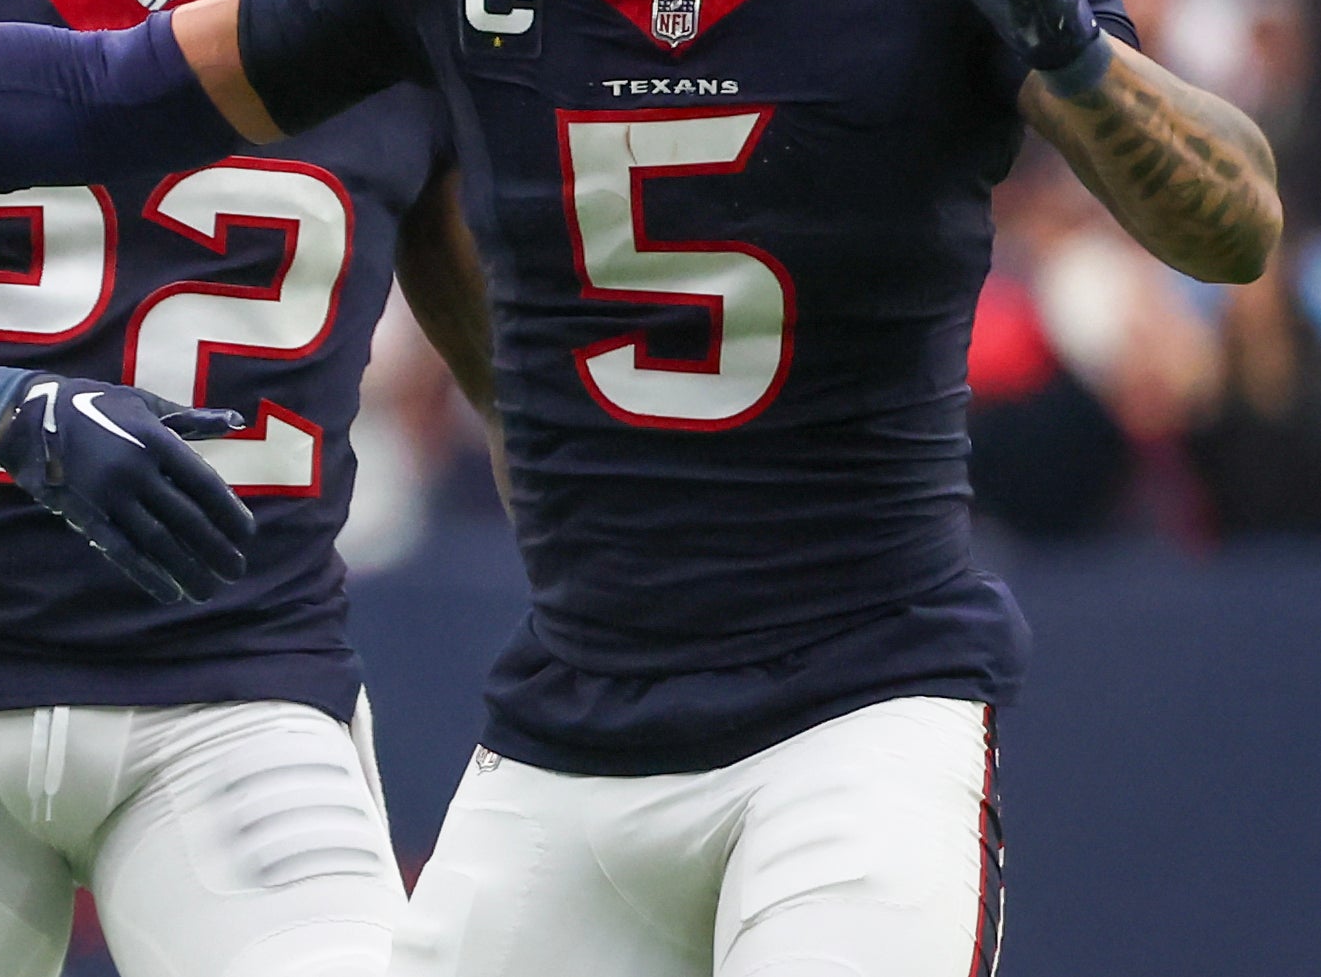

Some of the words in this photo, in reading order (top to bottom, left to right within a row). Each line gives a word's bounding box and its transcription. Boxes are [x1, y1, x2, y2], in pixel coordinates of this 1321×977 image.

[659, 12, 691, 35] NFL
[602, 78, 740, 97] TEXANS
[554, 103, 798, 433] 5
